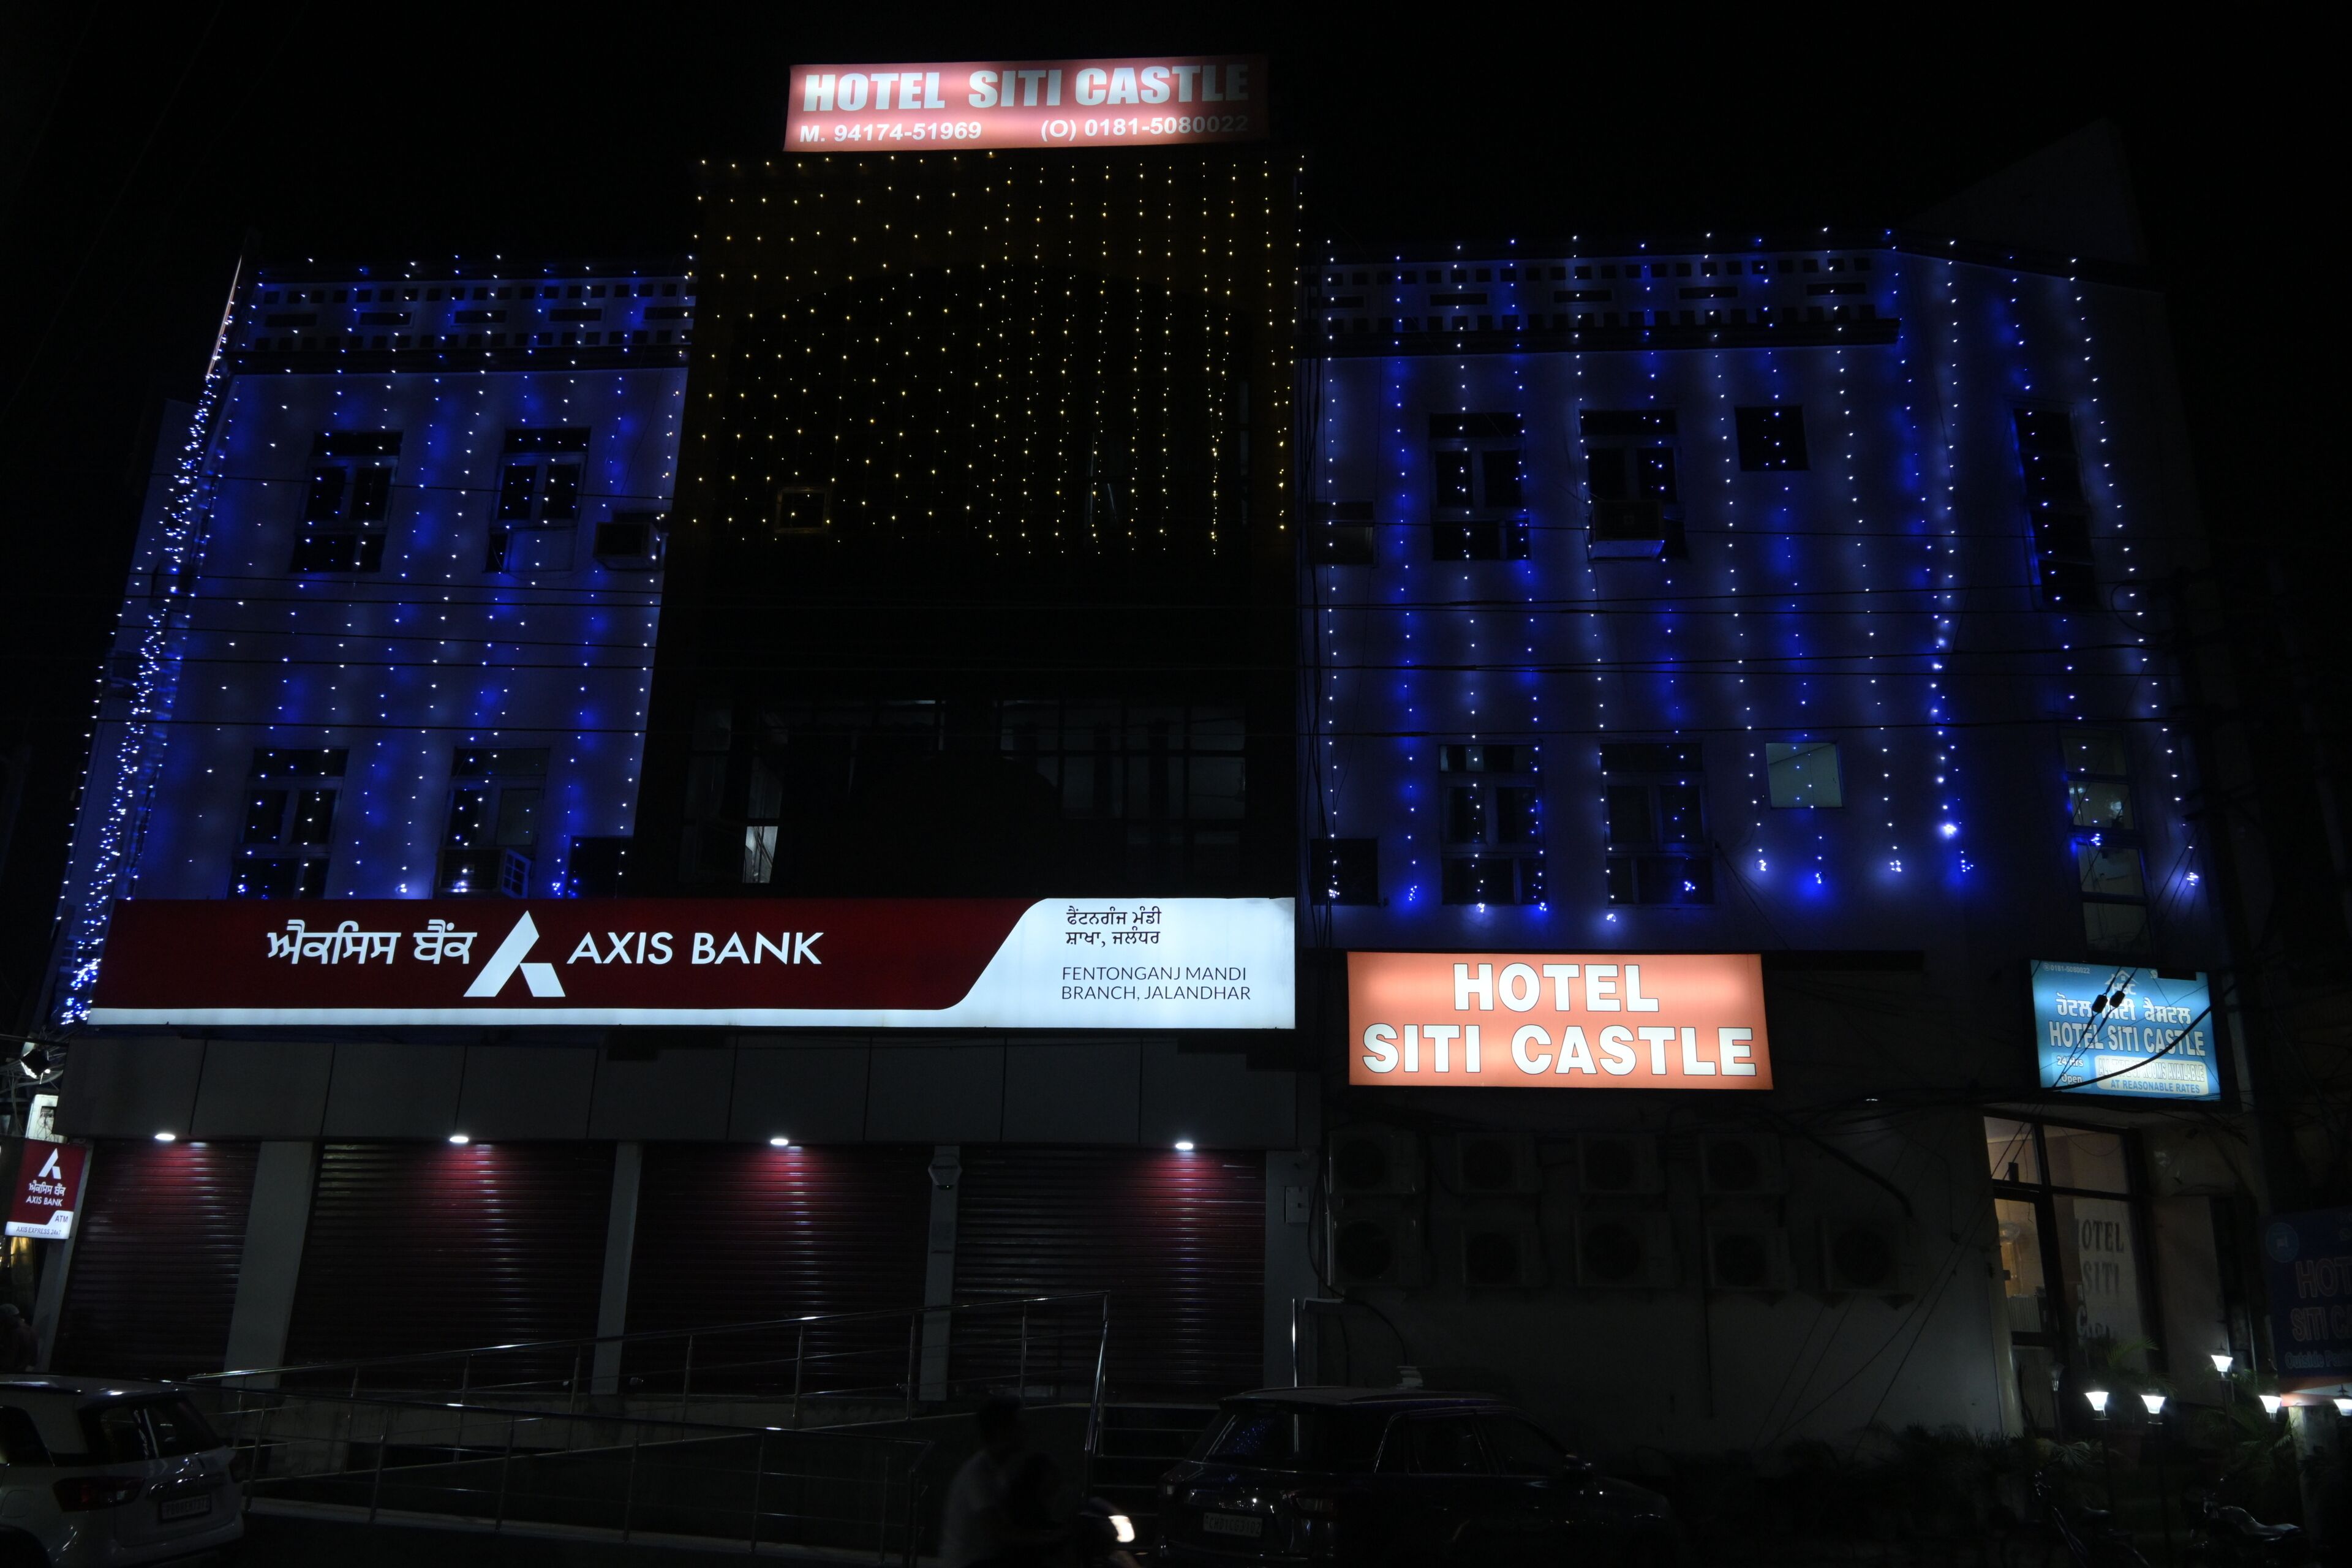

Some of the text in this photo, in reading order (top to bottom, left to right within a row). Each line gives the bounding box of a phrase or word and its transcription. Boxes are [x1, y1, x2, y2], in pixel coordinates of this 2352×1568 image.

[803, 64, 1250, 111] HOTEL SITI CASTLE
[800, 115, 1250, 143] M. 94174-51969 (O) 0181-5080022
[1066, 906, 1162, 925] ਫੈਂਟਨਗੰਜ ਮੰਡੀ
[267, 919, 477, 964] ਐਕਸਿਸ ਬੈਂਕ
[1066, 925, 1161, 948] ਸ਼ਾਖਾ, ਜਲੰਧਰ
[567, 932, 824, 965] AXIS BANK
[1062, 967, 1246, 981] FENTONGANJ MANDI
[1061, 986, 1251, 1002] BRANCH, JALANDHAR
[1453, 962, 1659, 1012] HOTEL
[1362, 1023, 1757, 1076] SITI CASTLE
[2049, 1021, 2206, 1057] HOTEL SITI CASTLE
[2056, 1055, 2067, 1066] 24
[2060, 1073, 2083, 1085] Open
[2168, 1063, 2206, 1082] AVAILABLE
[2111, 1080, 2200, 1094] AT REASONABLE RATES
[26, 1195, 63, 1207] AXIS BANK
[2291, 1306, 2329, 1342] SITI
